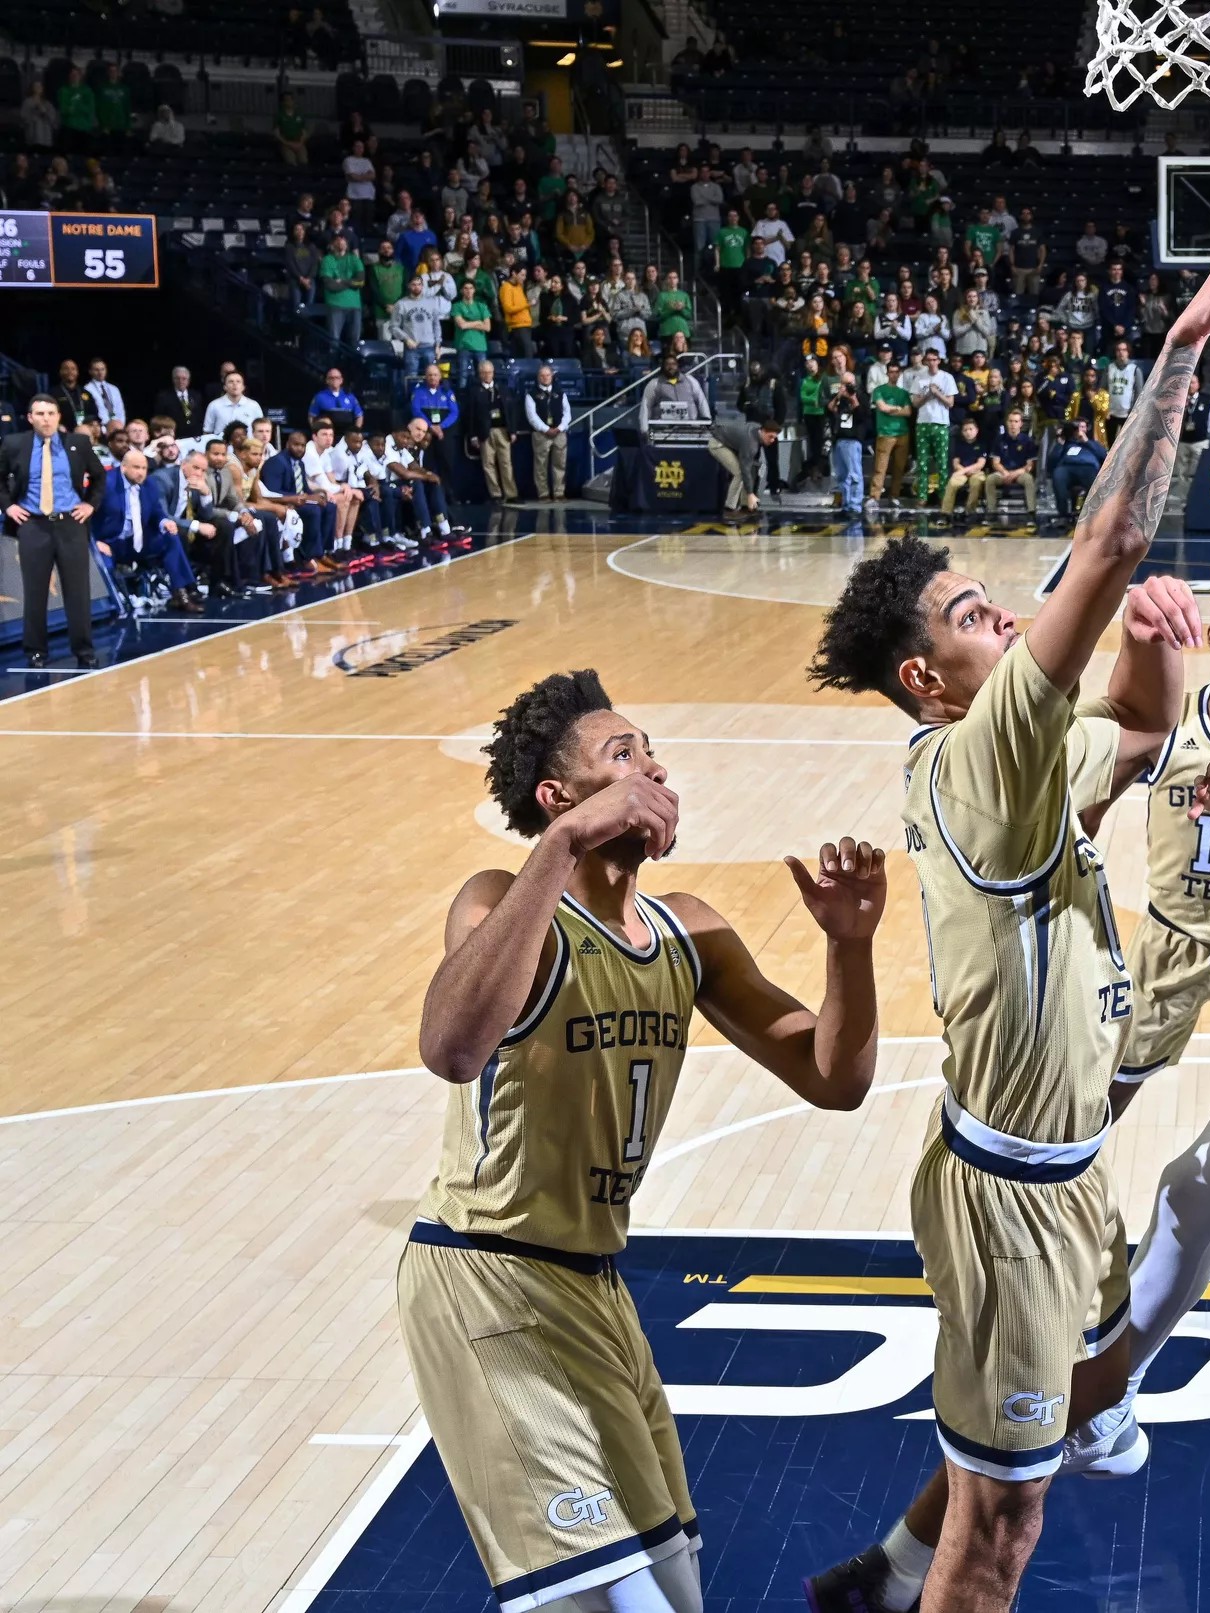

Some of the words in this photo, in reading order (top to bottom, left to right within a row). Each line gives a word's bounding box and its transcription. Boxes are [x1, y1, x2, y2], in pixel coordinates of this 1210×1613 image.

[62, 223, 104, 236] NOTRE
[107, 224, 142, 237] DAME
[17, 259, 46, 269] FOULS
[26, 269, 36, 281] 6
[84, 248, 126, 279] 55
[623, 1059, 653, 1163] 1
[1001, 1391, 1065, 1427] GT
[547, 1486, 613, 1529] GT
